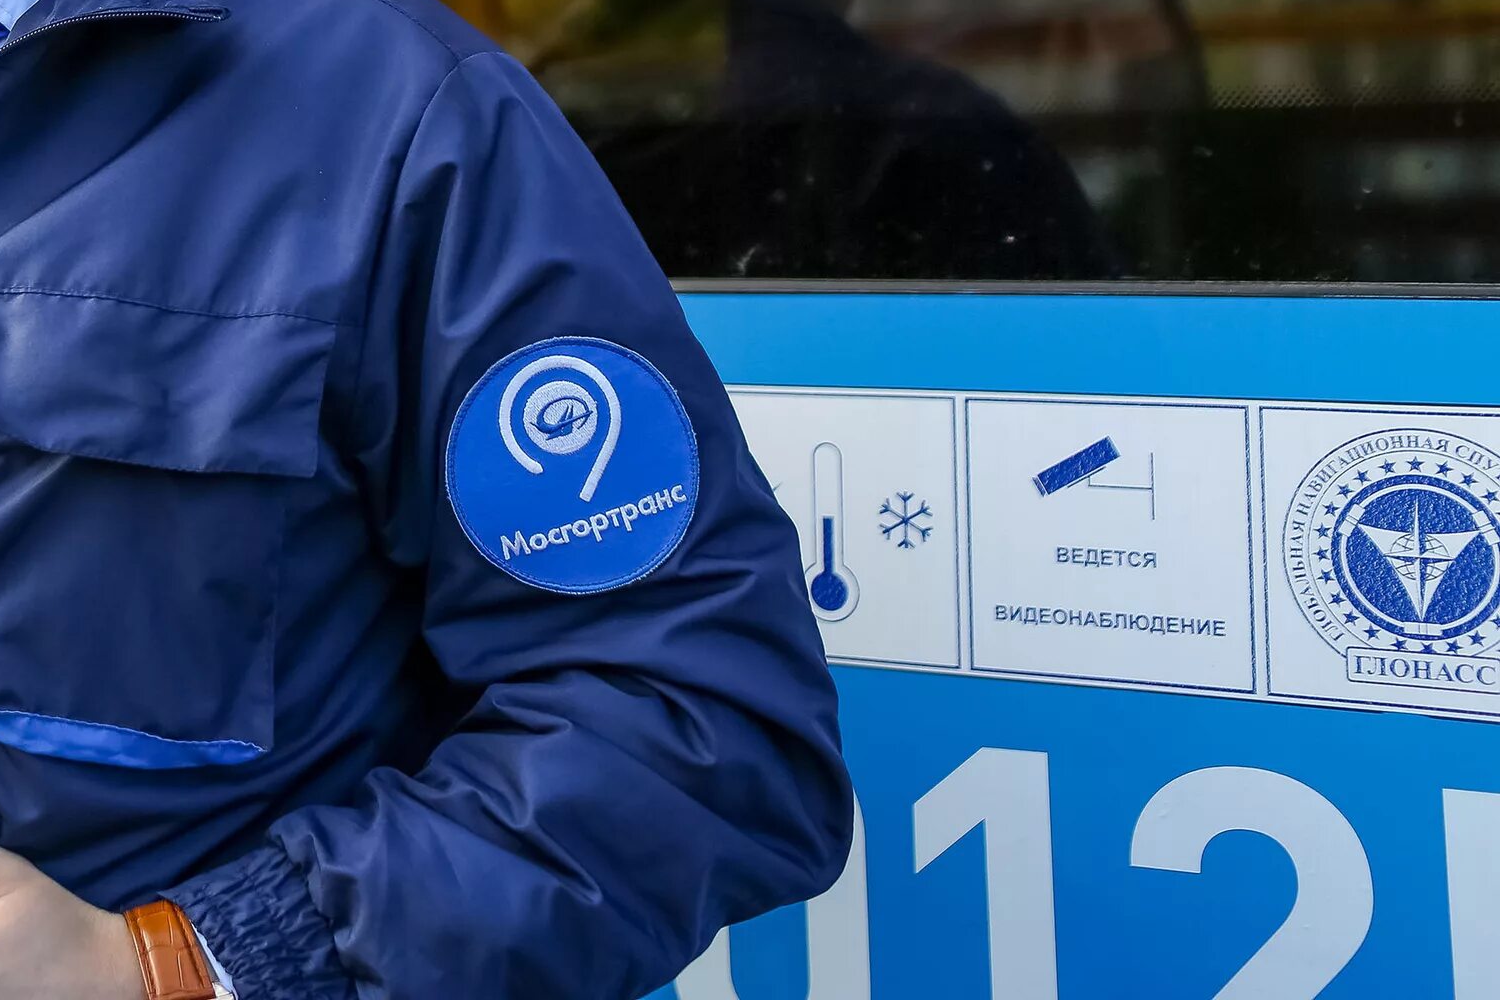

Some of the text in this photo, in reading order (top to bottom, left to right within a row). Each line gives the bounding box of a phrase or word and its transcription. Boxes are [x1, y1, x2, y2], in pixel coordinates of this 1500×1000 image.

[500, 485, 687, 560] Мосгортранс
[1289, 435, 1500, 641] ГЛОБАЛЬНАЯ НАВИГАЦИОННАЯ СПУ
[1056, 546, 1158, 568] ВЕДЕТСЯ
[995, 604, 1227, 637] ВИДЕОНАБЛЮДЕНИЕ
[1354, 655, 1497, 685] ГЛОНАСС
